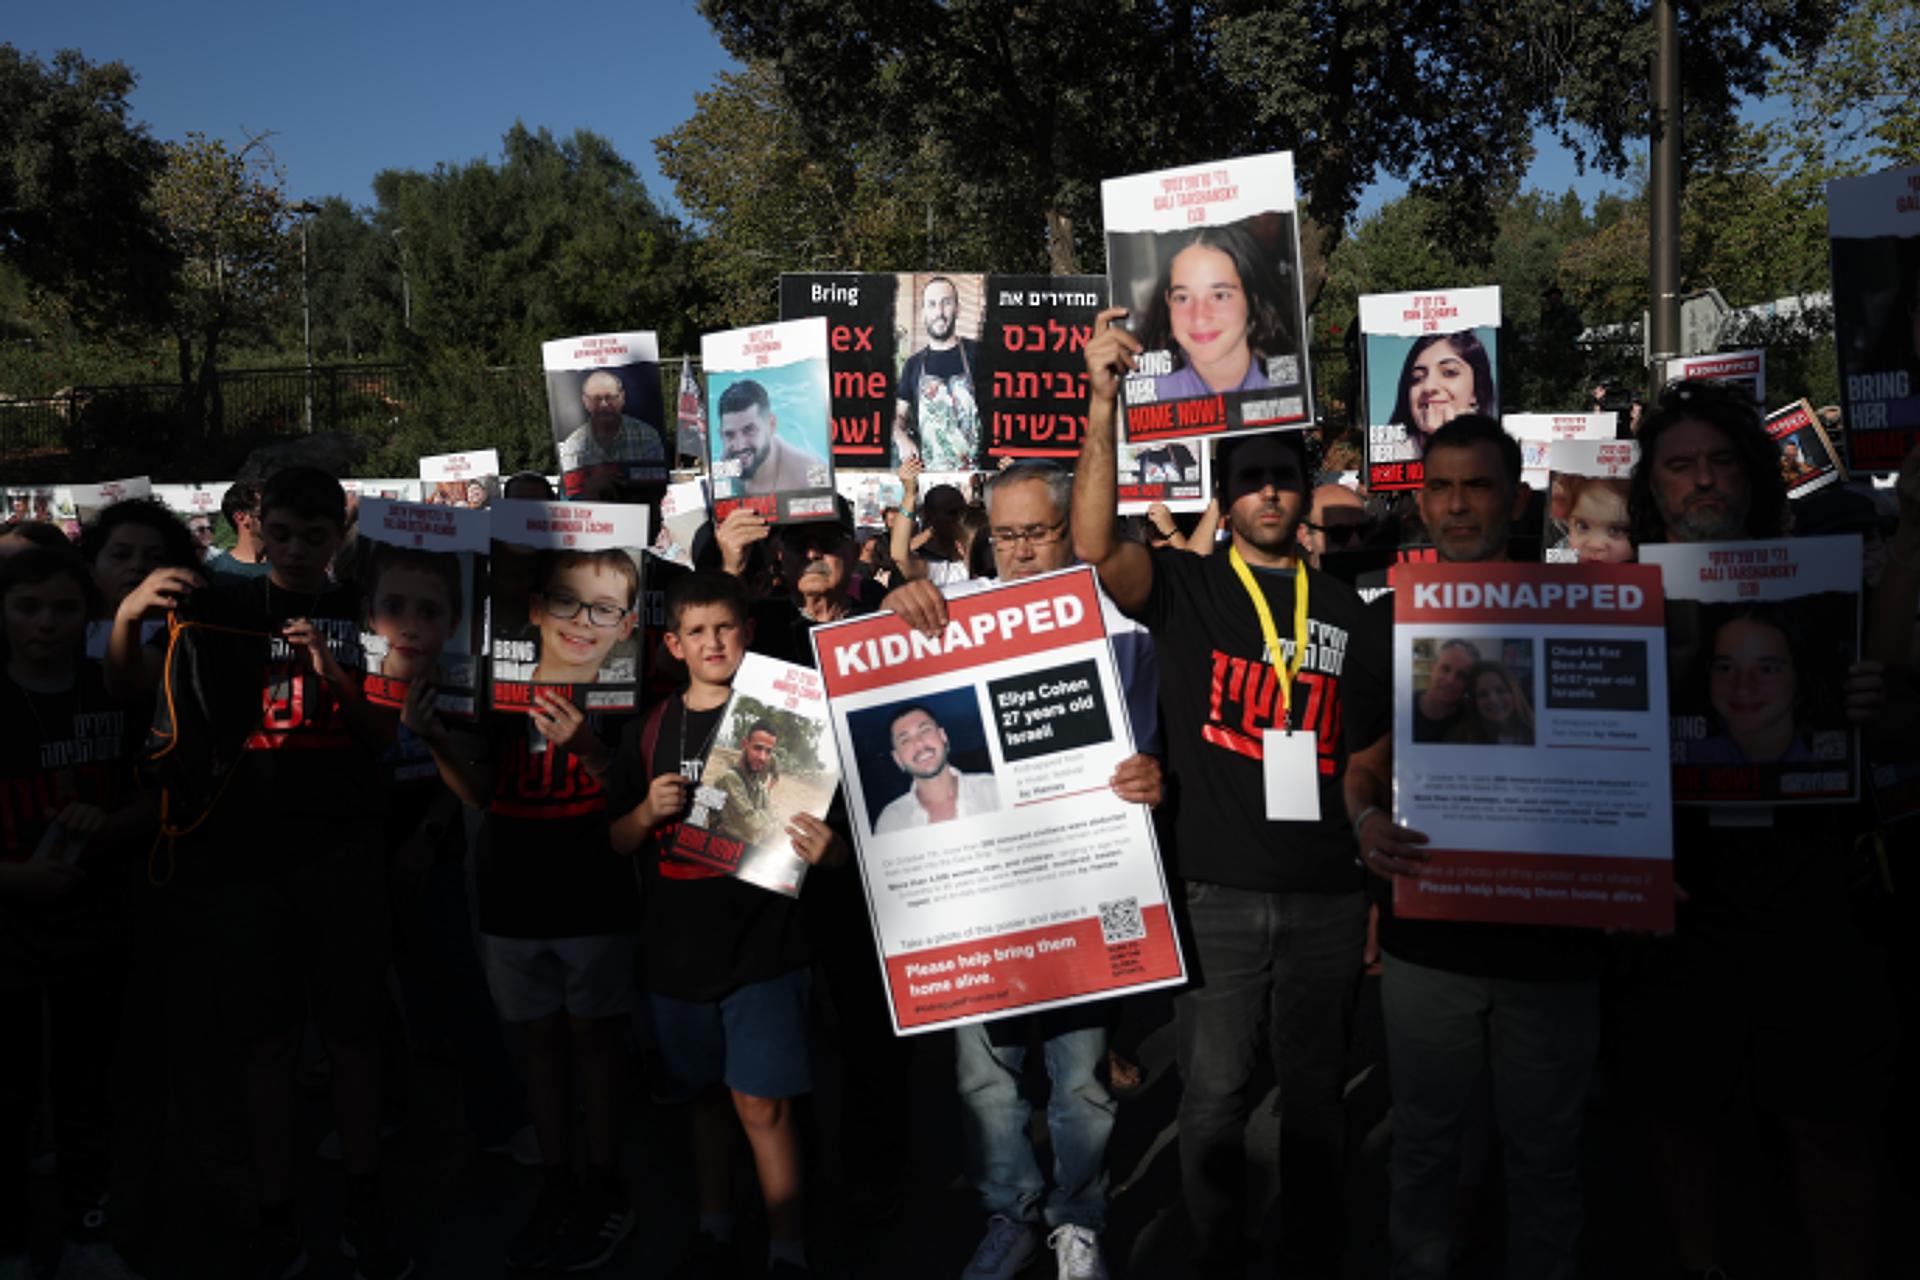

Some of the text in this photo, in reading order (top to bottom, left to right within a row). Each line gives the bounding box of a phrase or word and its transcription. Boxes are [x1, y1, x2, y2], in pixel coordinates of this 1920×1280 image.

[811, 284, 859, 306] Bring
[1000, 291, 1098, 306] מחזירים את
[831, 325, 874, 352] ex
[1003, 319, 1093, 352] אלכס
[1688, 361, 1756, 376] KIDNAPPED
[834, 370, 887, 399] me
[1847, 370, 1910, 399] BRING
[1129, 405, 1173, 431] HOME
[1177, 393, 1226, 425] NOW!
[1850, 402, 1889, 429] HER
[1700, 564, 1798, 581] GALI TARSHANSKY
[1413, 582, 1645, 611] KIDNAPPED
[834, 594, 1085, 677] KIDNAPPED
[493, 640, 536, 660] BRING
[1040, 678, 1089, 699] Cohen
[1002, 695, 1095, 727] 27 years old
[1005, 723, 1055, 746] Israeli
[1419, 879, 1461, 895] Please
[1465, 882, 1493, 897] help
[1496, 883, 1532, 900] bring
[1535, 885, 1569, 898] them
[1571, 887, 1610, 901] home
[905, 935, 1077, 979] Please help bring them
[910, 973, 995, 998] home alive.
